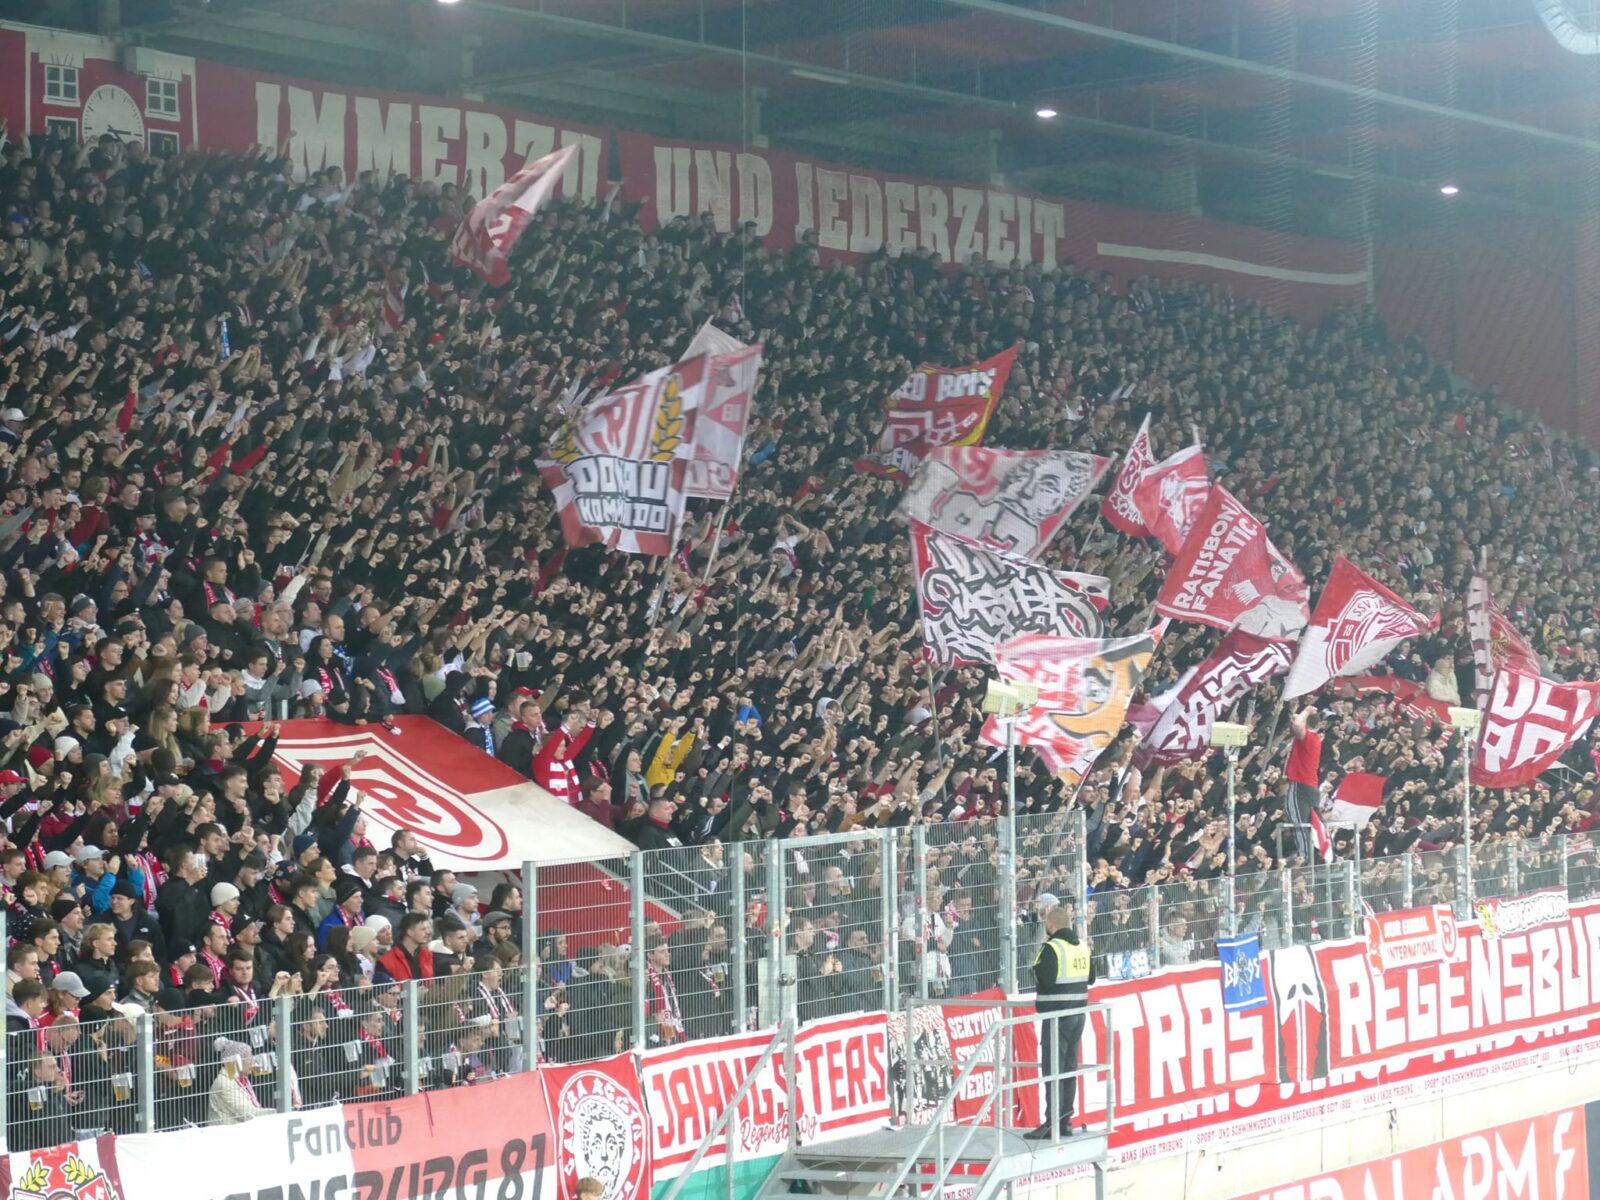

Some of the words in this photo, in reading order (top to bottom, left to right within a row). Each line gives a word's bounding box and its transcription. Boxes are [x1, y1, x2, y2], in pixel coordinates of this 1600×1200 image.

[653, 145, 773, 237] UND
[794, 160, 1065, 272] JEDERZEIT
[1172, 503, 1240, 609] RATISBON
[1191, 518, 1257, 611] FANATIC
[1073, 957, 1087, 970] 413
[1036, 979, 1266, 1119] LTRAS
[1331, 911, 1600, 1059] REGENSBU
[286, 1105, 402, 1165] Fanclub
